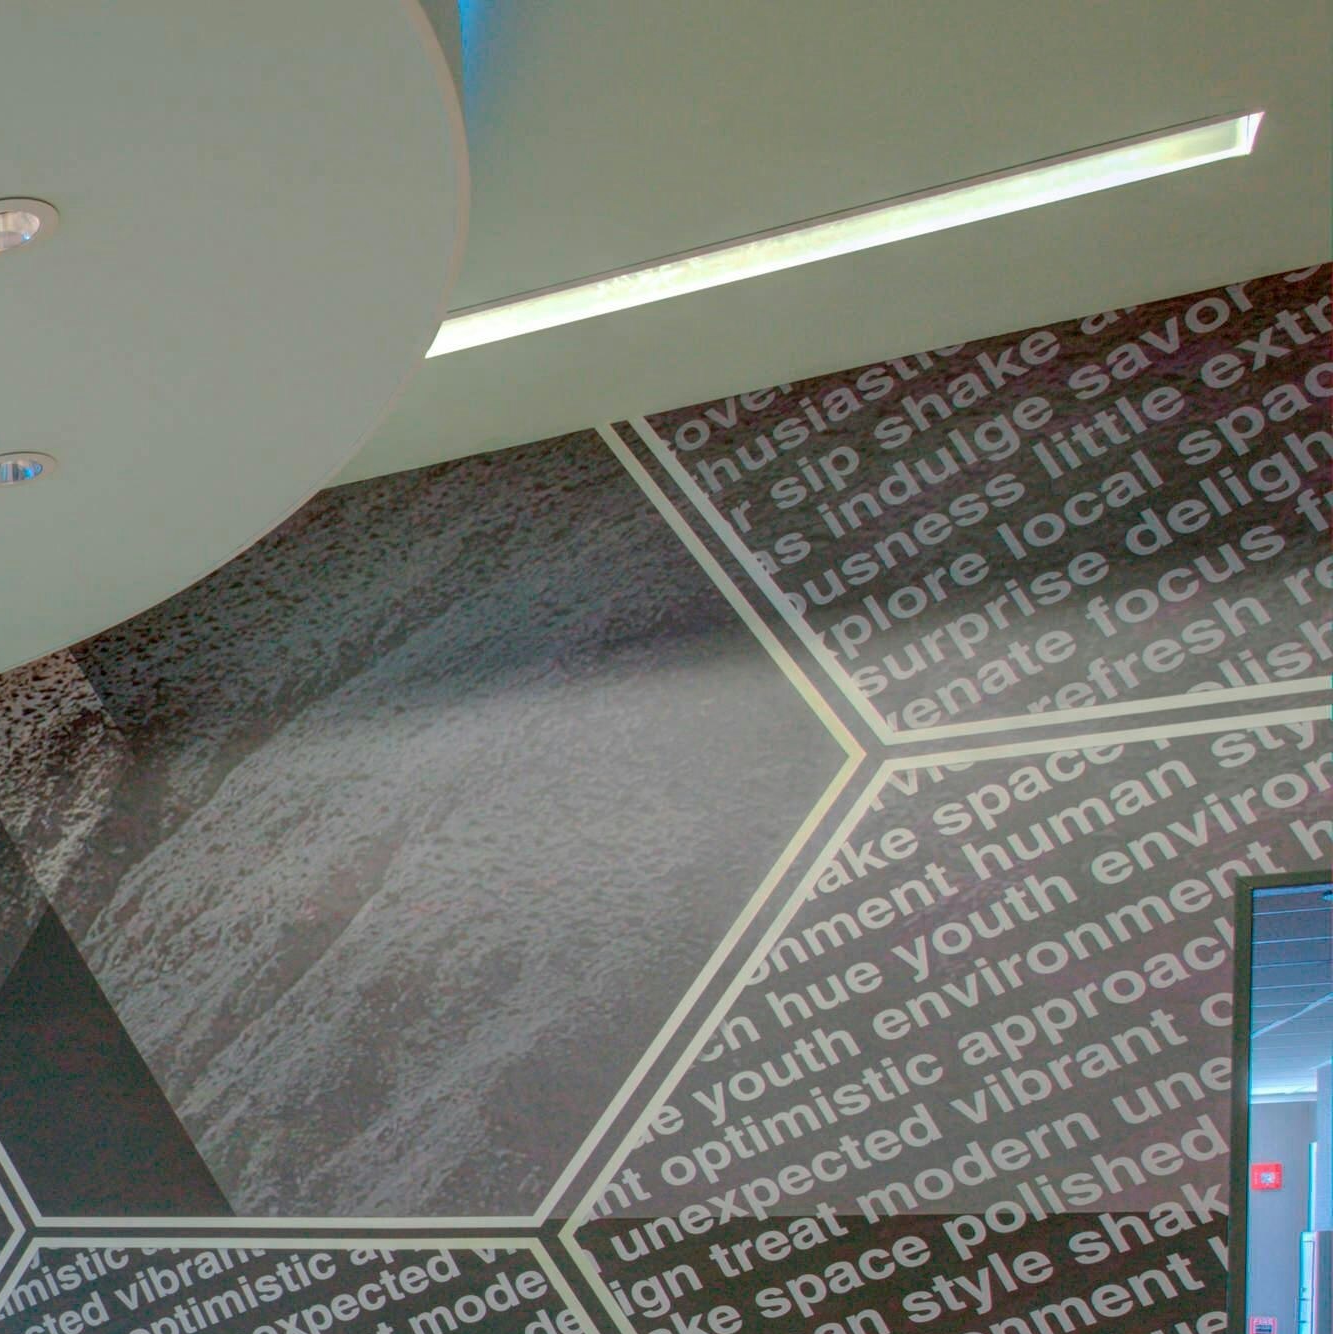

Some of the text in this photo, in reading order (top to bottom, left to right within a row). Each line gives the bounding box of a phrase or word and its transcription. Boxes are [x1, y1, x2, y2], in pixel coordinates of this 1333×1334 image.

[1068, 282, 1253, 399] savor
[771, 331, 1061, 509] sip shake
[817, 396, 1053, 538] indulge
[1032, 386, 1184, 479] little
[997, 450, 1164, 560] local
[851, 552, 1110, 698] surprise
[1085, 525, 1285, 638] focus
[1027, 598, 1271, 714] refresh
[933, 744, 1124, 835] space
[962, 760, 1197, 880] human
[692, 841, 1286, 1127] youth environment
[765, 962, 883, 1028] hue
[891, 873, 1078, 983] youth
[610, 1009, 1188, 1262] unexpected vibrant
[661, 1054, 943, 1185] optimistic
[709, 1202, 849, 1278] treat
[856, 1112, 1101, 1224] modern
[756, 1236, 930, 1318] space
[943, 1114, 1230, 1261] polished
[115, 1248, 266, 1311] vibrant
[902, 1251, 1054, 1323] style
